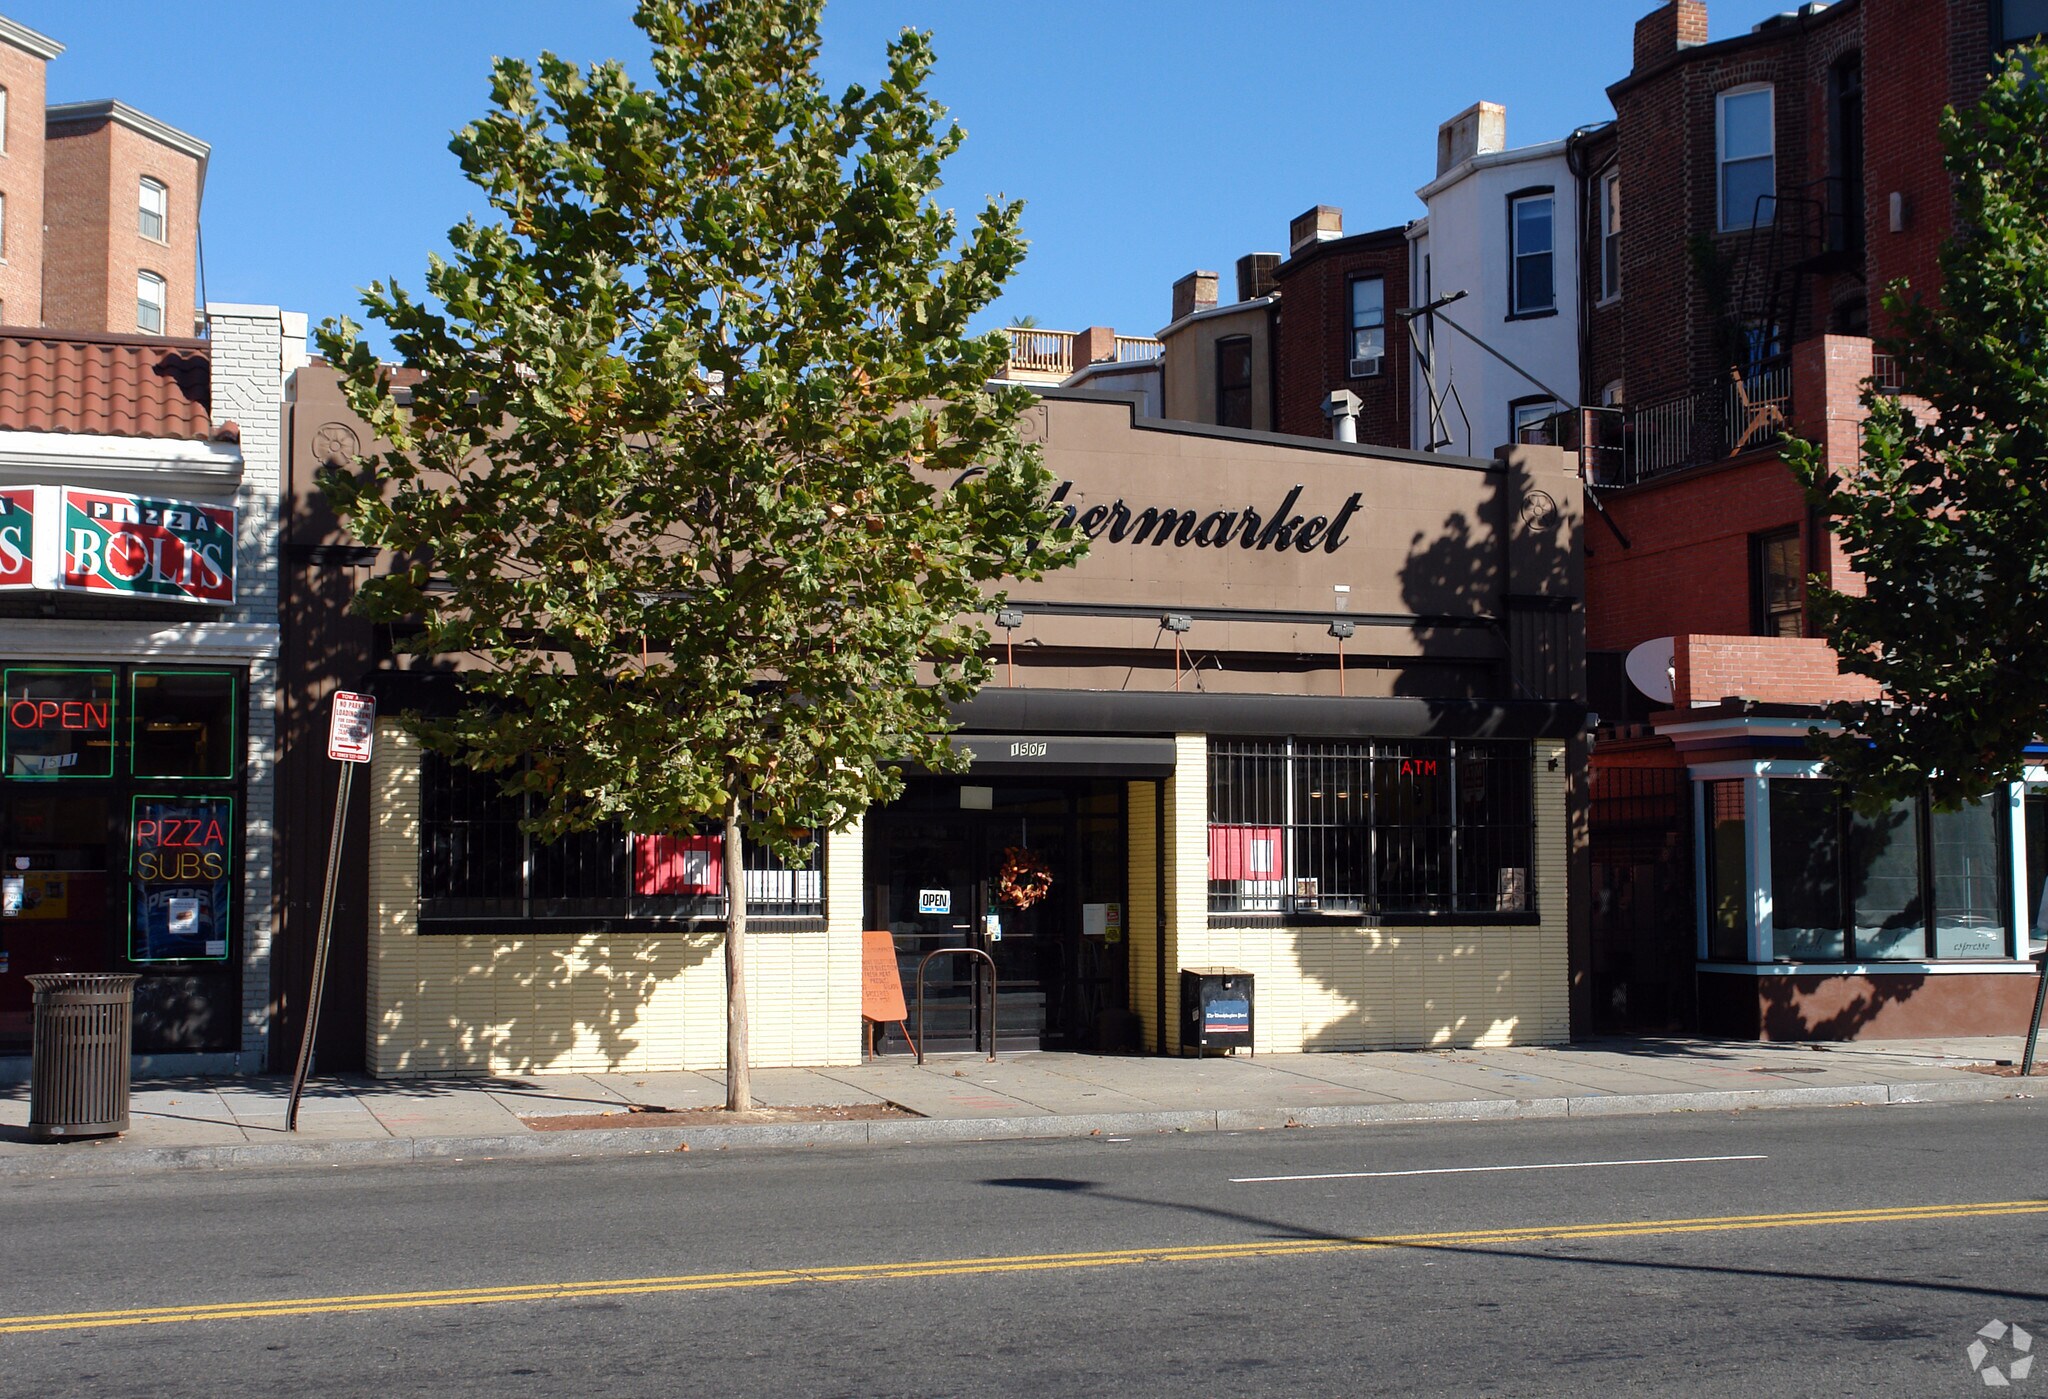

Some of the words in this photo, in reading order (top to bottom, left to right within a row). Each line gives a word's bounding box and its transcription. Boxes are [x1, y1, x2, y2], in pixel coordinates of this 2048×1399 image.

[94, 502, 208, 531] PIZZA
[69, 527, 223, 589] BOLI'S
[336, 709, 357, 717] LOADING
[348, 702, 370, 710] PARKING
[11, 701, 108, 729] OPEN
[1012, 744, 1046, 756] 1507
[41, 754, 74, 769] 1511
[1401, 760, 1437, 776] ATM
[137, 820, 224, 846] PIZZA
[137, 852, 223, 879] SUBS
[922, 894, 947, 907] OPEN
[1953, 942, 1990, 958] espresso
